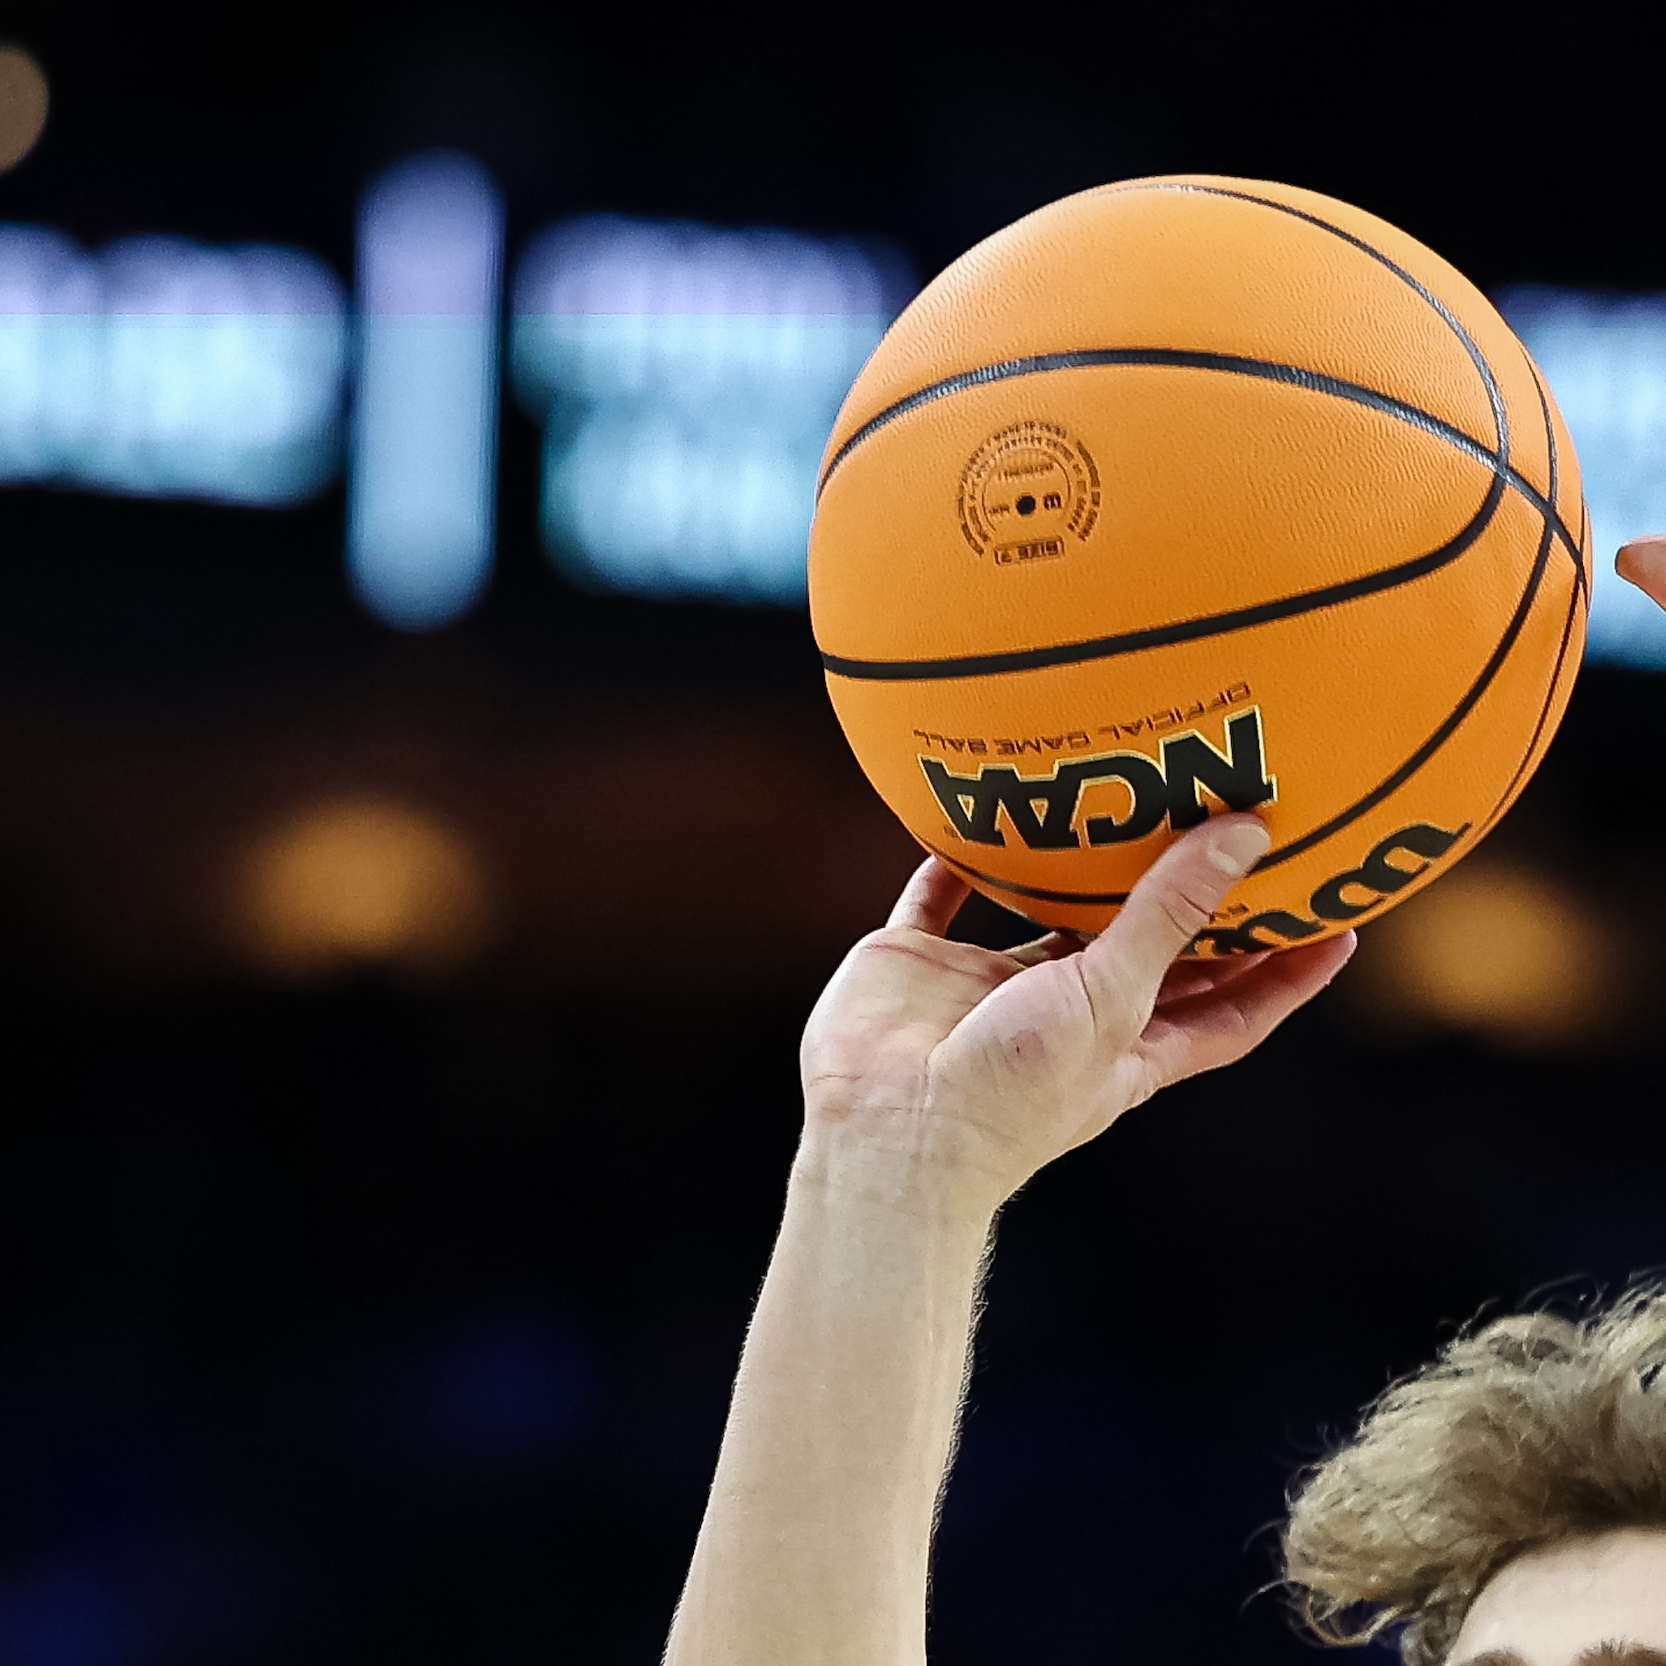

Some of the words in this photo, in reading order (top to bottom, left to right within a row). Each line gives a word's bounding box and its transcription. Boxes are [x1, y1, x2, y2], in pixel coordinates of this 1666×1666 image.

[1098, 681, 1251, 740] OFFICIAL
[913, 729, 987, 755] BALL
[993, 730, 1091, 755] GAME
[917, 705, 1278, 850] NCAA
